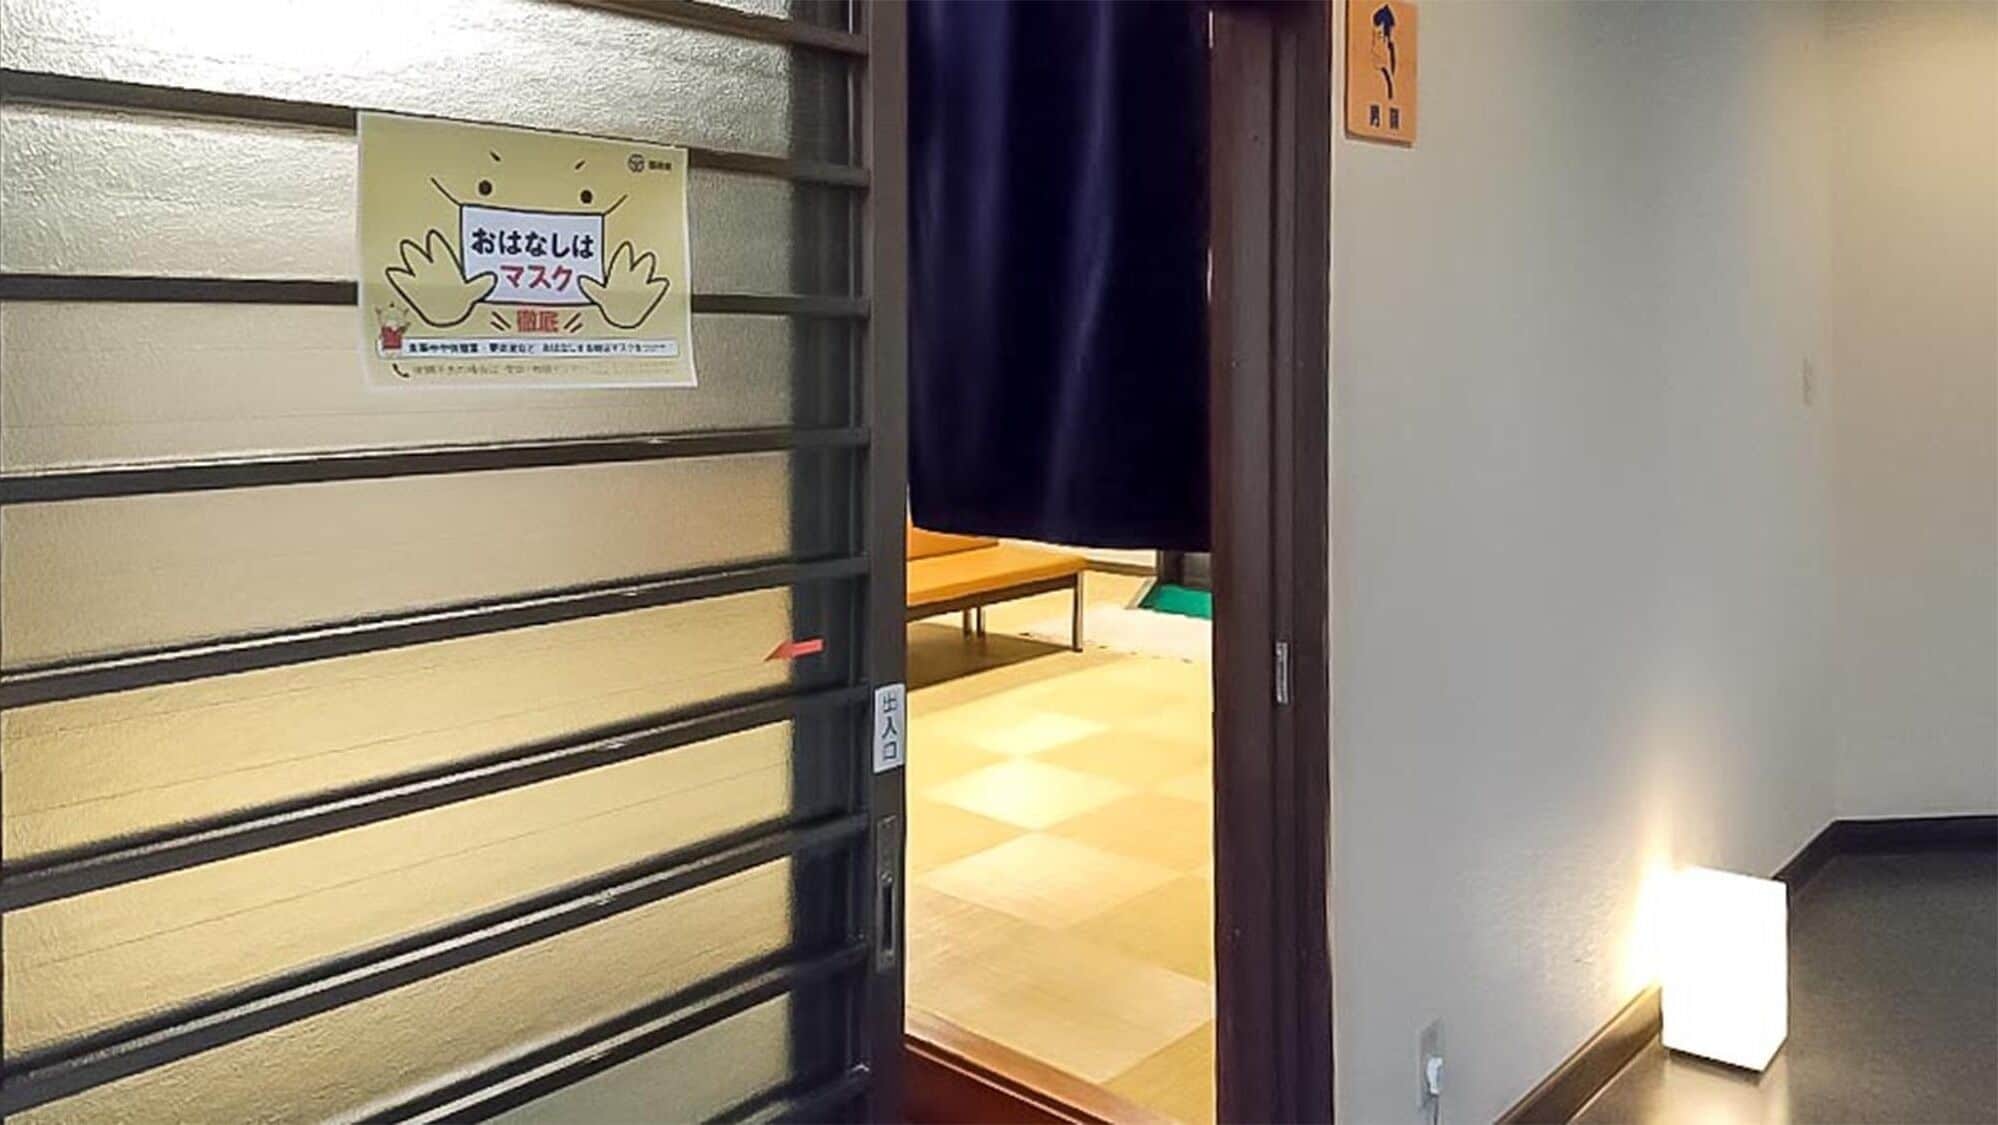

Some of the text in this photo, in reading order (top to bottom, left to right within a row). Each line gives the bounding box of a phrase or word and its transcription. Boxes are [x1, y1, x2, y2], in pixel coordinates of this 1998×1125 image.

[471, 226, 595, 259] おはなしは
[499, 264, 573, 292] マスク
[881, 691, 898, 761] 出入口
